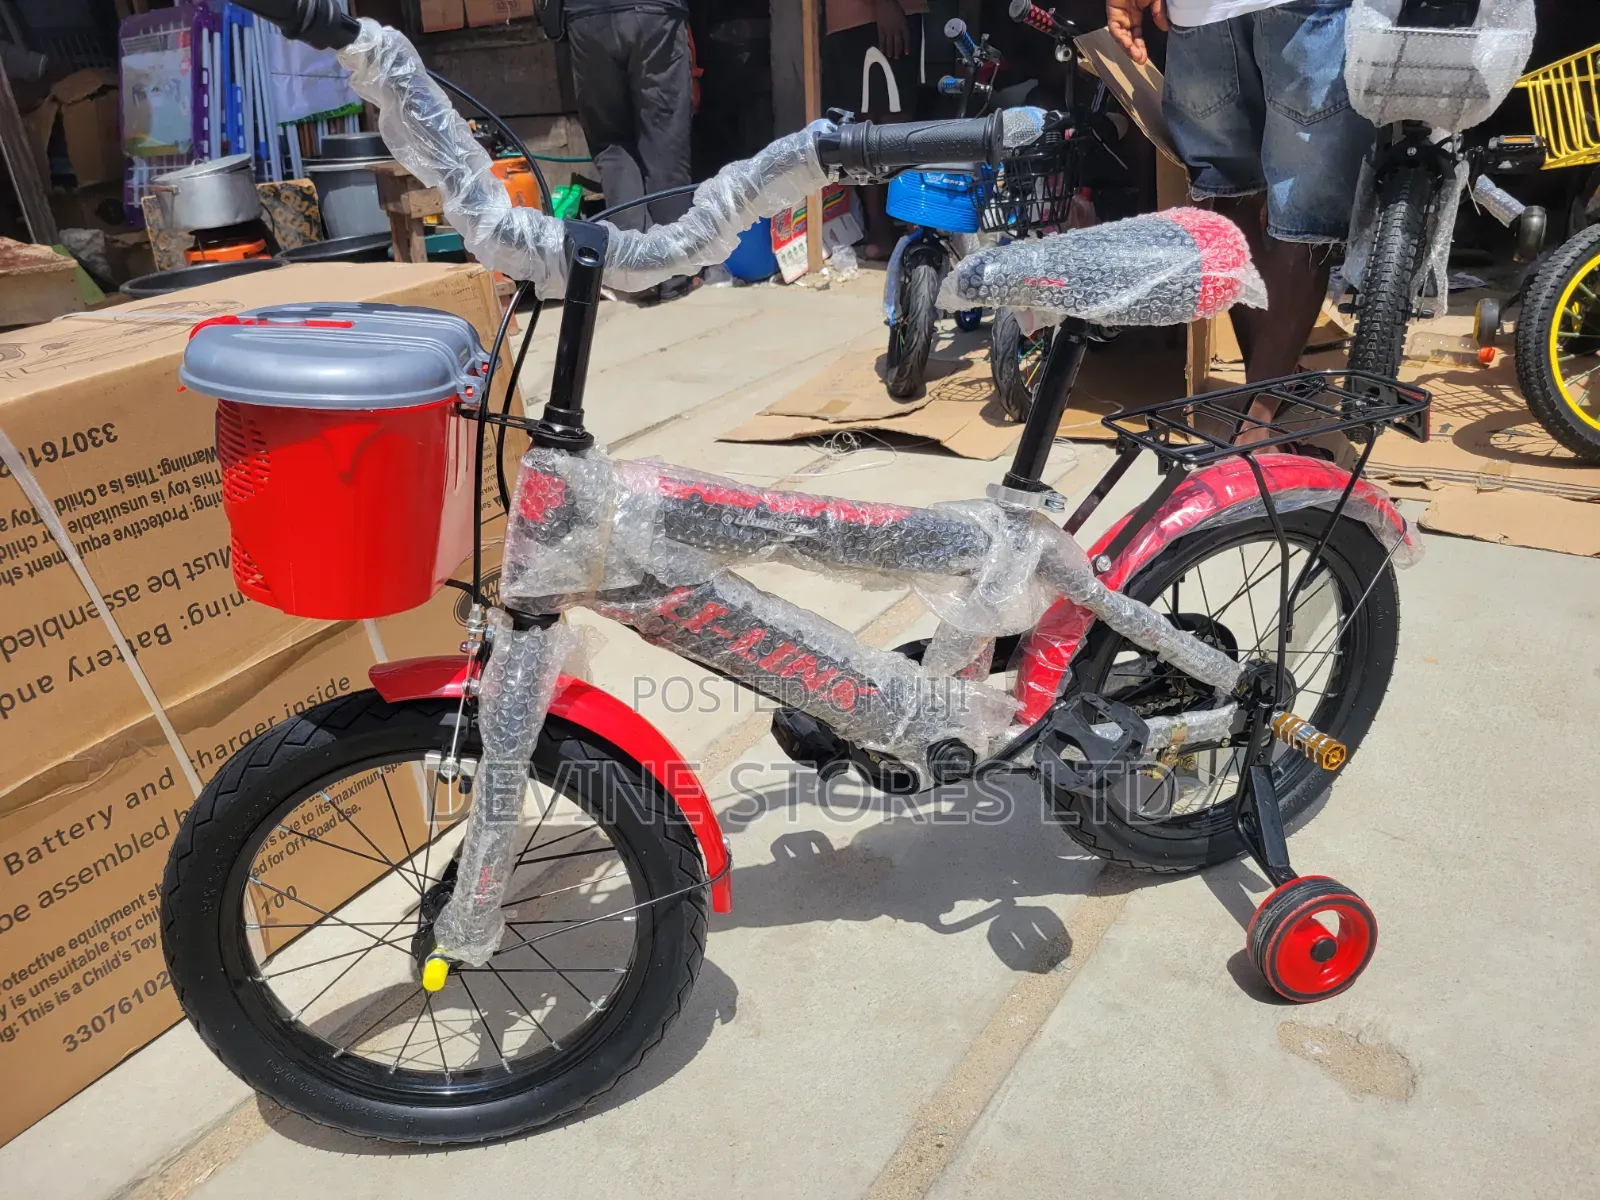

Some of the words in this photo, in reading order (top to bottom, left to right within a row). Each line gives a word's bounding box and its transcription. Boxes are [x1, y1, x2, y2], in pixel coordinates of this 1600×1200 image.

[124, 467, 160, 489] This
[157, 446, 218, 477] Warning:
[191, 469, 222, 490] This
[96, 483, 109, 498] a
[109, 478, 125, 495] is
[150, 489, 167, 505] is
[167, 480, 192, 499] toy
[67, 494, 149, 535] unsuitable
[113, 504, 190, 542] Protective
[25, 532, 111, 579] equiment
[146, 567, 182, 594] be
[3, 804, 113, 876] Battery
[124, 766, 175, 810] and
[283, 675, 351, 719] inside
[301, 811, 315, 827] to
[315, 800, 331, 817] its
[267, 849, 285, 869] for
[336, 802, 362, 822] Use.
[37, 816, 171, 909] assembled
[68, 893, 147, 951] equipment
[9, 993, 27, 1010] is
[28, 940, 110, 998] unsuitable
[110, 923, 133, 946] for
[17, 1001, 55, 1028] This
[54, 989, 71, 1006] is
[71, 981, 83, 996] a
[82, 951, 132, 988] Child's
[131, 931, 157, 956] Toy
[62, 969, 172, 1053] 33076102
